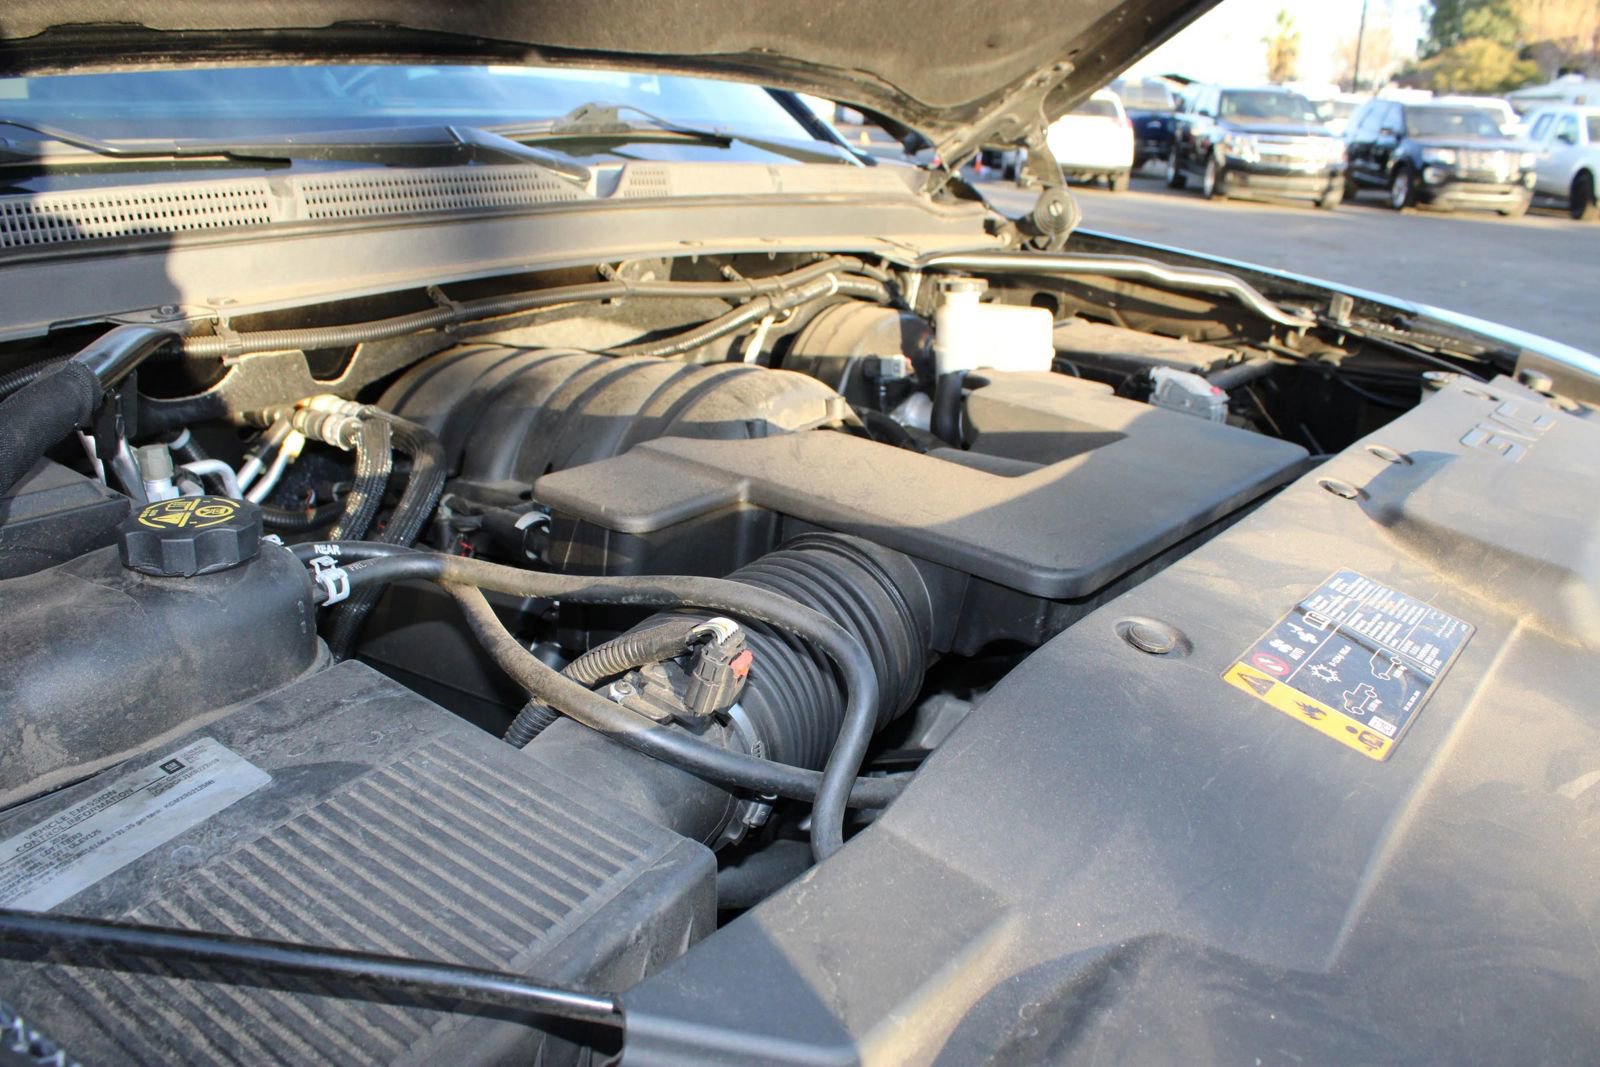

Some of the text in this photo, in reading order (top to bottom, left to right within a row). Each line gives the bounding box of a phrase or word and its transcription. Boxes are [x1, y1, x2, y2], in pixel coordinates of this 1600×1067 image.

[314, 544, 341, 555] REAR
[16, 825, 68, 853] CONTROL
[67, 787, 134, 826] INFORMATION
[24, 789, 118, 841] VEHICLE EMISSION
